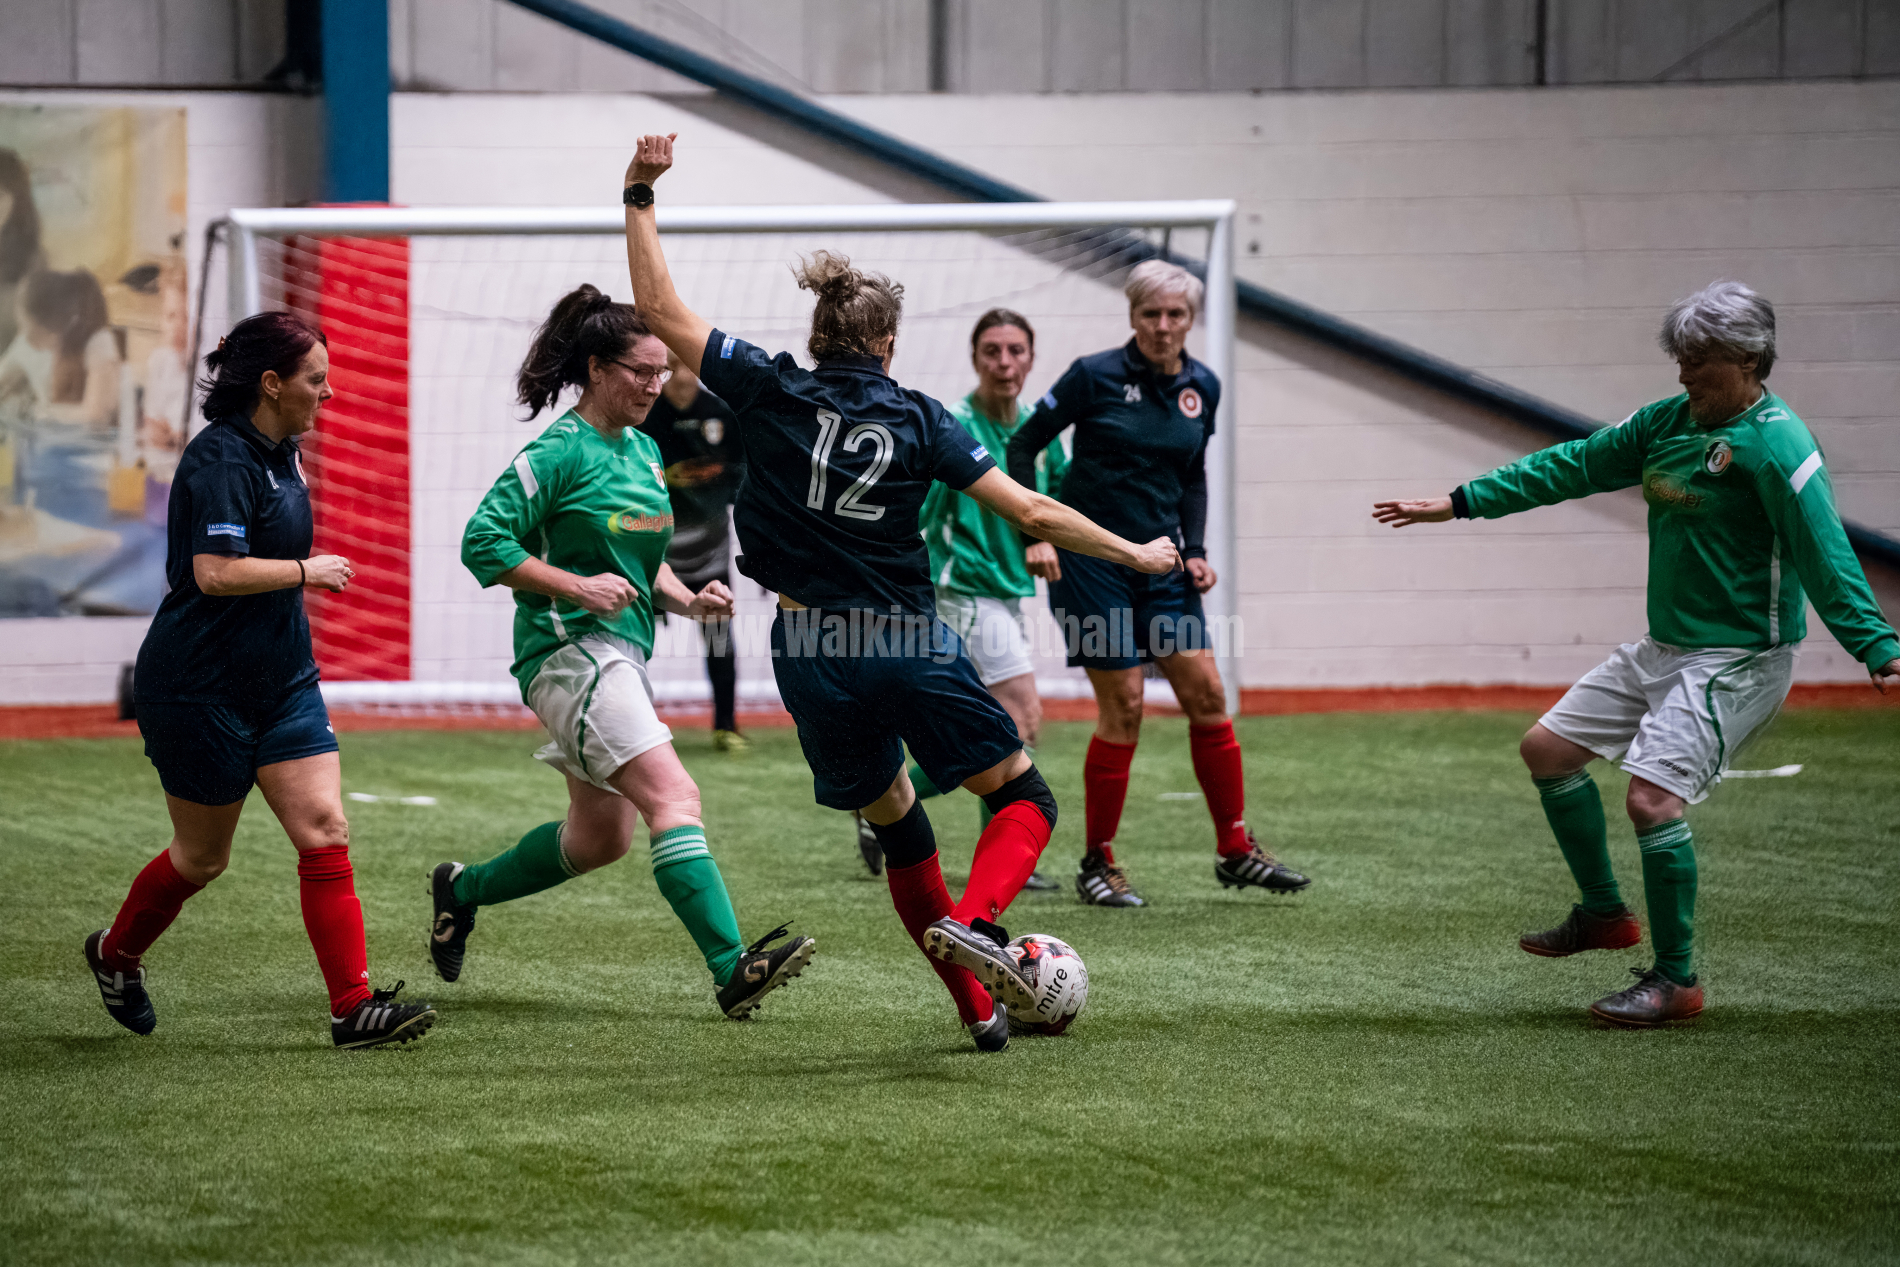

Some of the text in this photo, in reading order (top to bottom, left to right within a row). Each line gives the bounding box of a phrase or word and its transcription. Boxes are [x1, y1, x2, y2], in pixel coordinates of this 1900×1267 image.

[1123, 383, 1142, 403] 24
[806, 407, 895, 521] 12
[1036, 967, 1068, 1015] mitre
